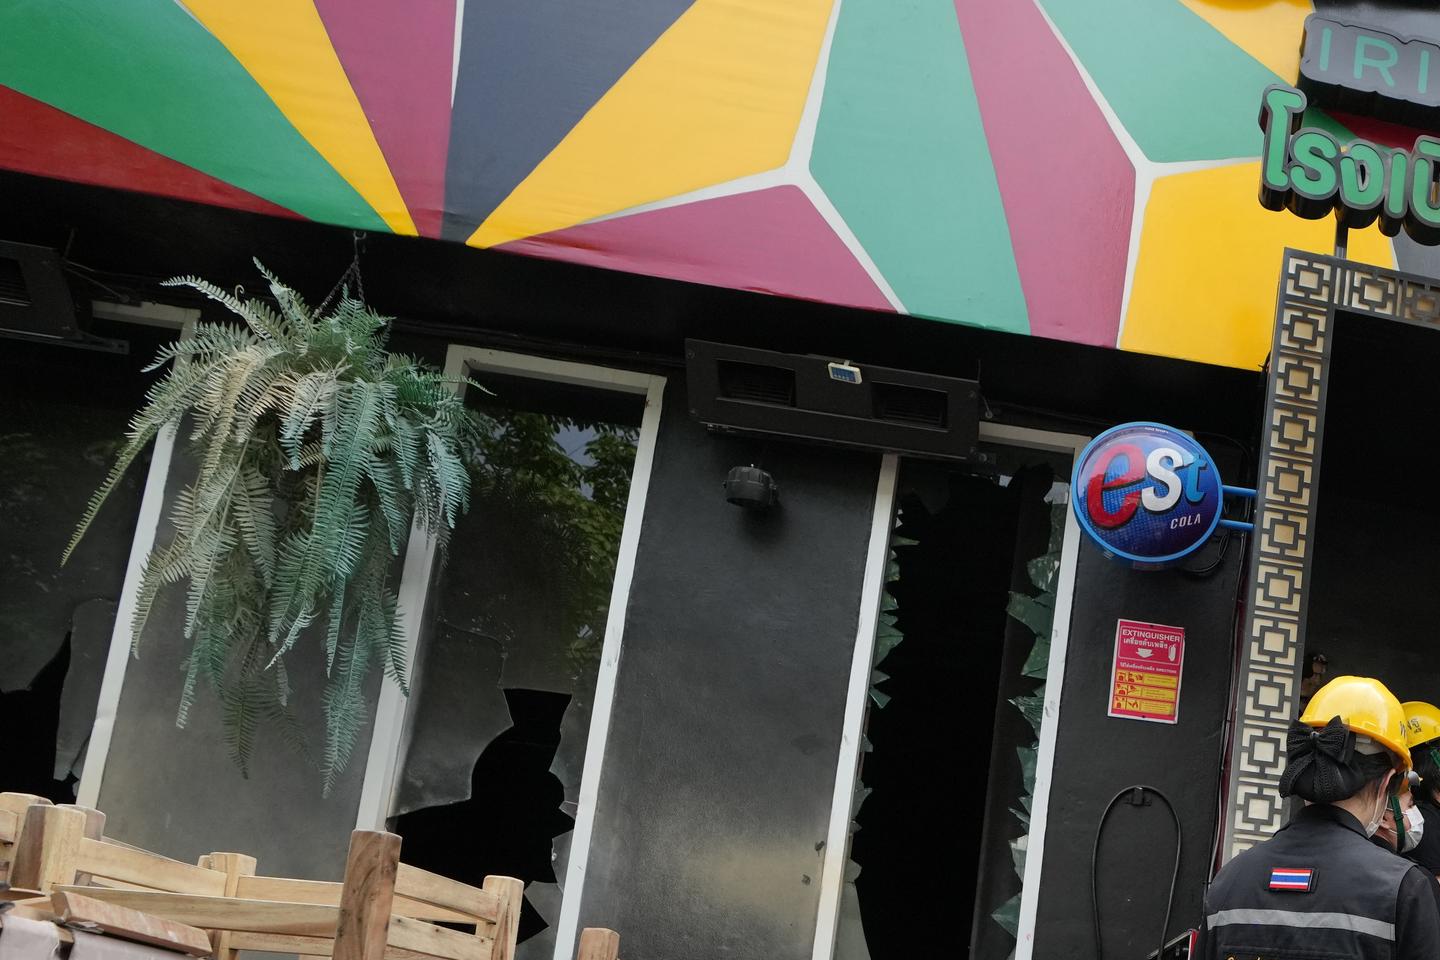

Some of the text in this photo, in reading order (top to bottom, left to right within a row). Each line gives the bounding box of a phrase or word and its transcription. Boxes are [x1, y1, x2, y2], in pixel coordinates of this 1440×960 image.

[1086, 442, 1210, 528] est
[1170, 514, 1202, 530] COLA
[1122, 628, 1181, 642] EXTINGUISHER
